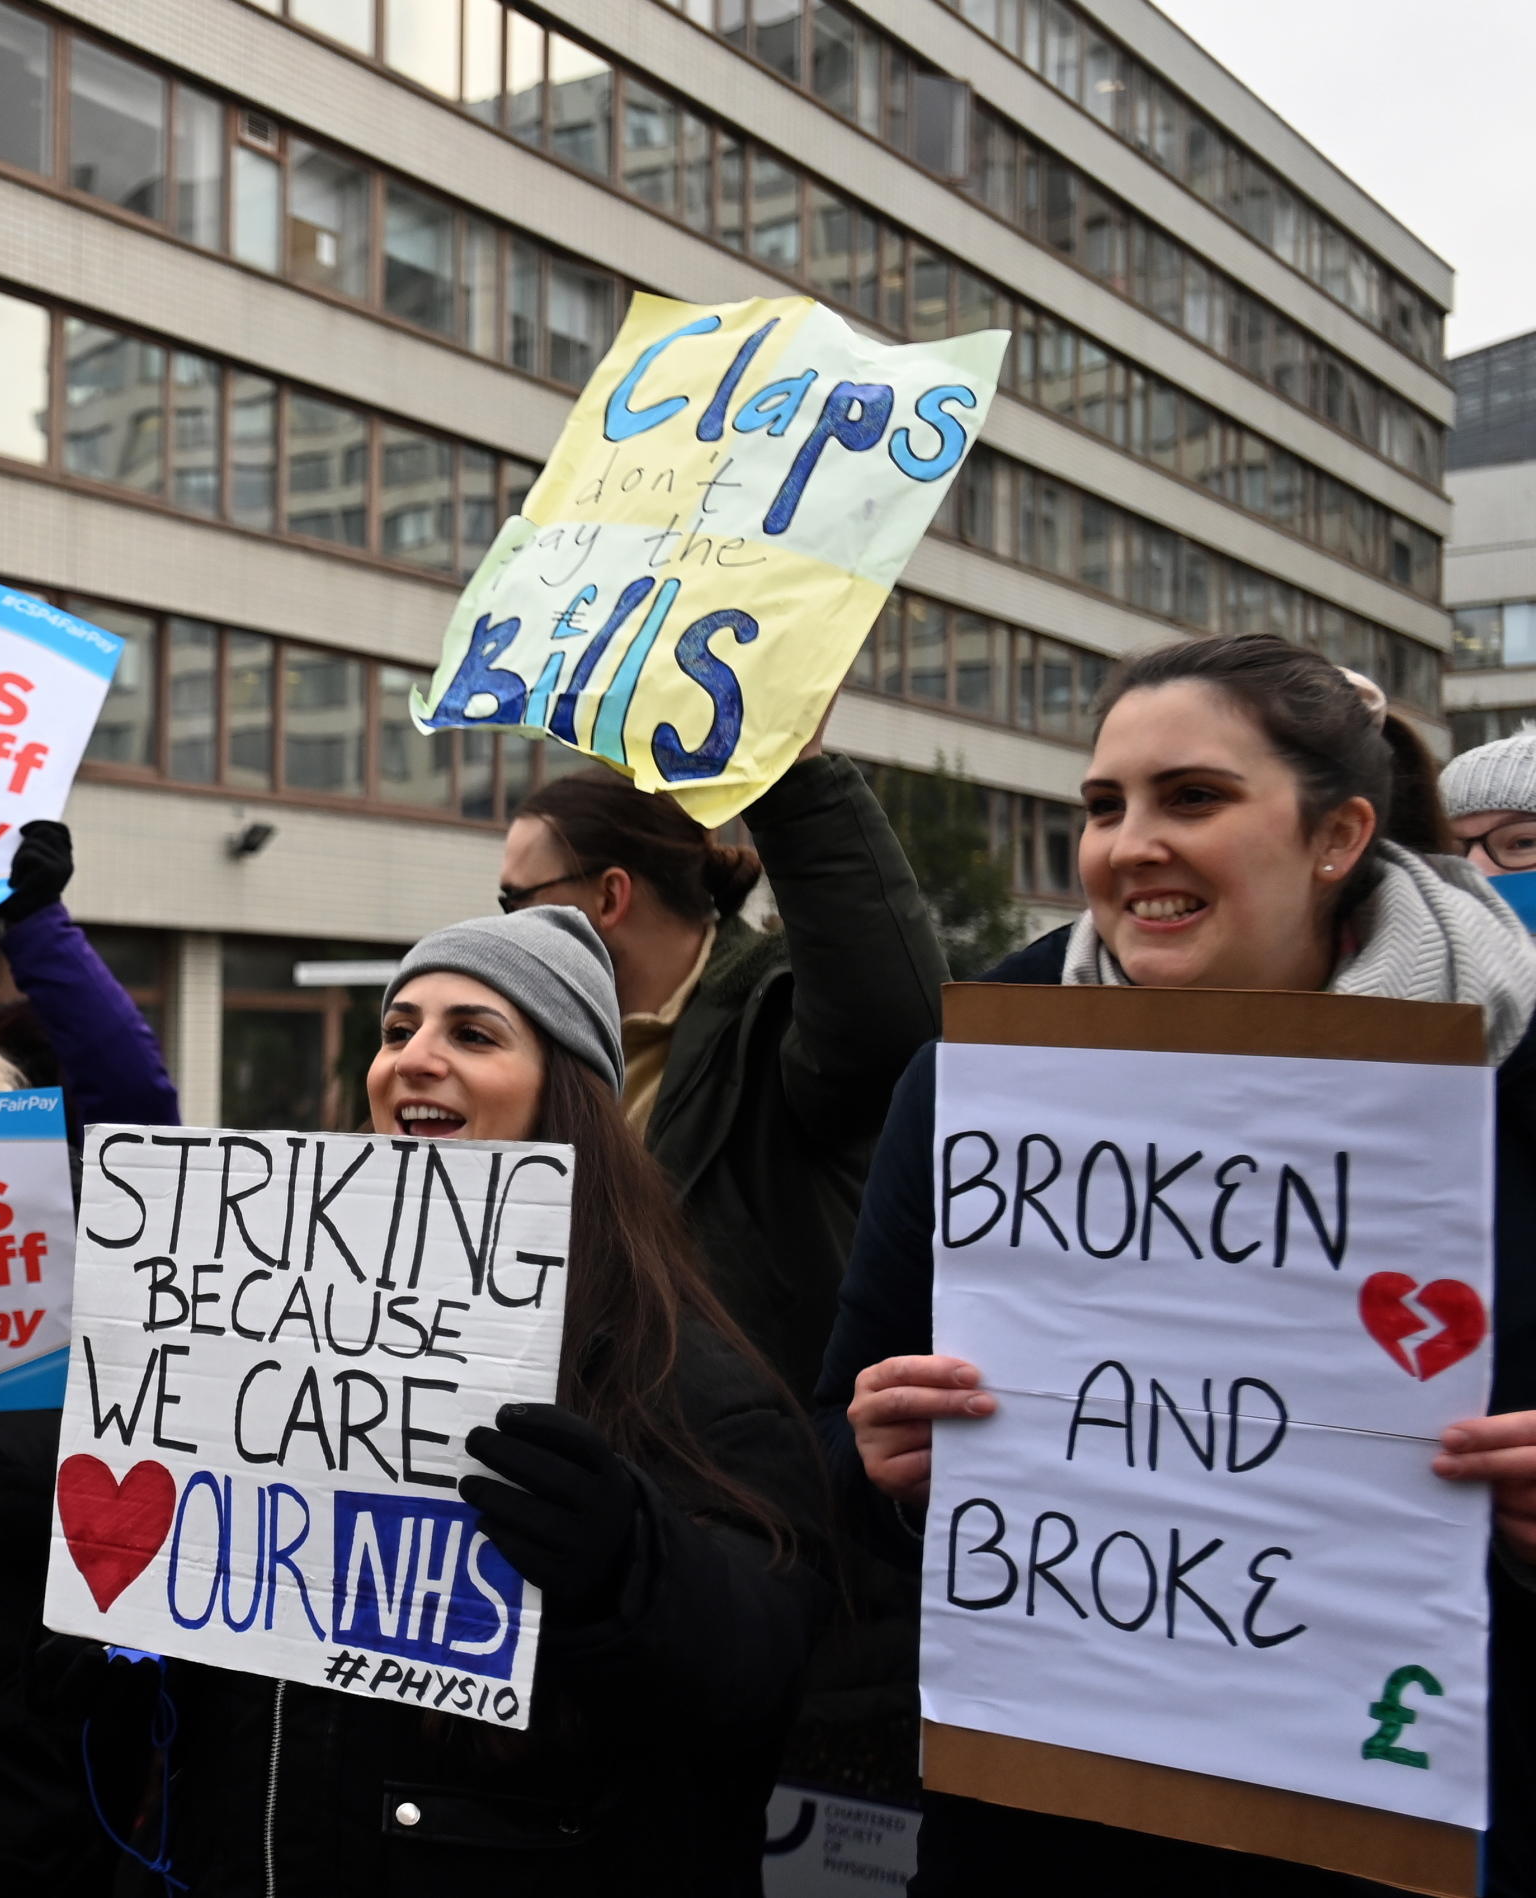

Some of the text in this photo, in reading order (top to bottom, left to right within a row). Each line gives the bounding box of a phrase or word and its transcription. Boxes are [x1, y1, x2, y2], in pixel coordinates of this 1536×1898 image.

[575, 447, 742, 514] don't
[603, 315, 977, 535] Claps
[644, 513, 767, 568] the
[0, 594, 119, 654] #CSP4FairPay
[86, 1132, 568, 1309] STRIKING
[942, 1130, 1350, 1271] BROKEN
[134, 1257, 470, 1363] BECAUSE
[83, 1336, 458, 1489] WE CARE
[1066, 1359, 1289, 1473] AND
[167, 1470, 510, 1656] OUR NHS
[947, 1498, 1308, 1649] BROKE
[324, 1649, 520, 1721] #PHYSIO
